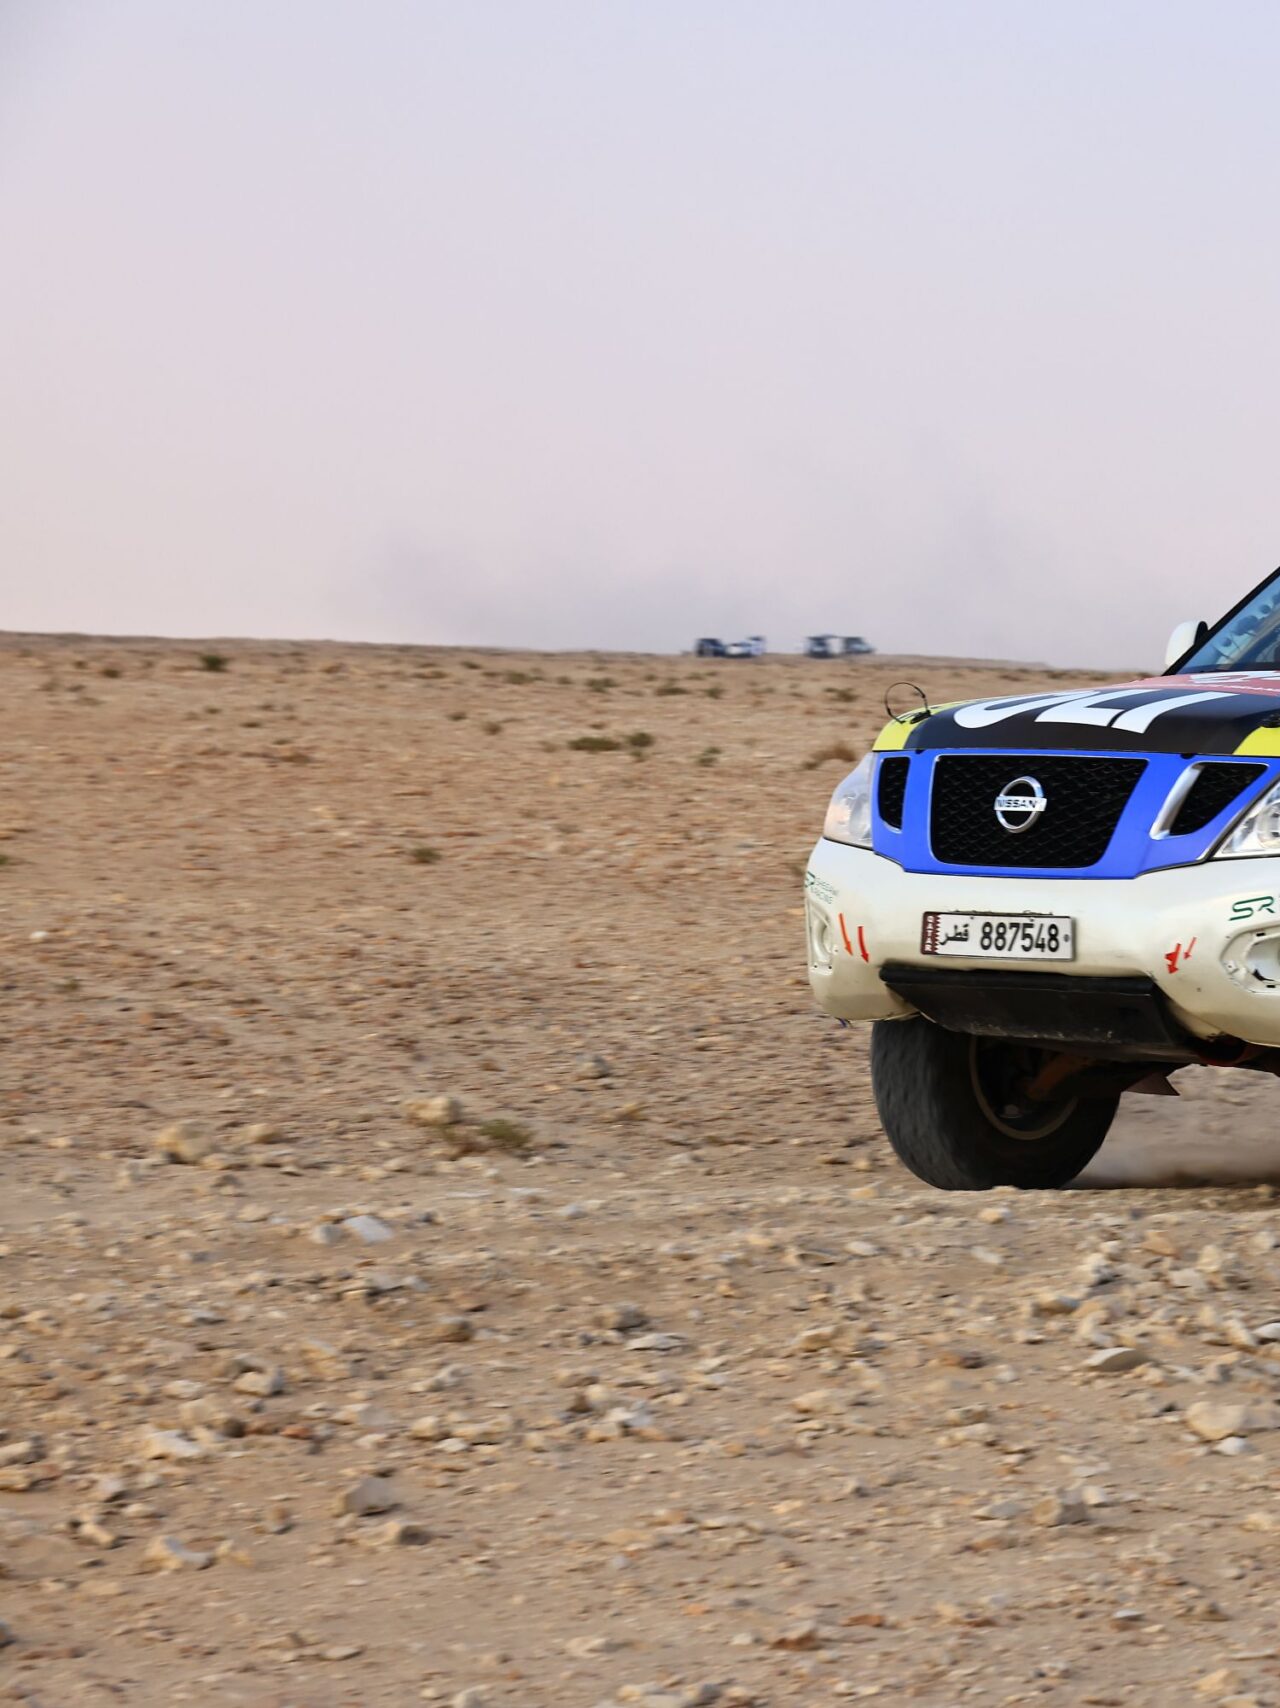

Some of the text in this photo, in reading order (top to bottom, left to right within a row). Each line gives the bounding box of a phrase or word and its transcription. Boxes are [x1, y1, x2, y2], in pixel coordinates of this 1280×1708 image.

[996, 798, 1039, 809] NISSAN
[1228, 895, 1276, 921] SR
[924, 915, 936, 952] QATAR
[940, 923, 970, 946] قطر
[980, 921, 1060, 953] 887548
